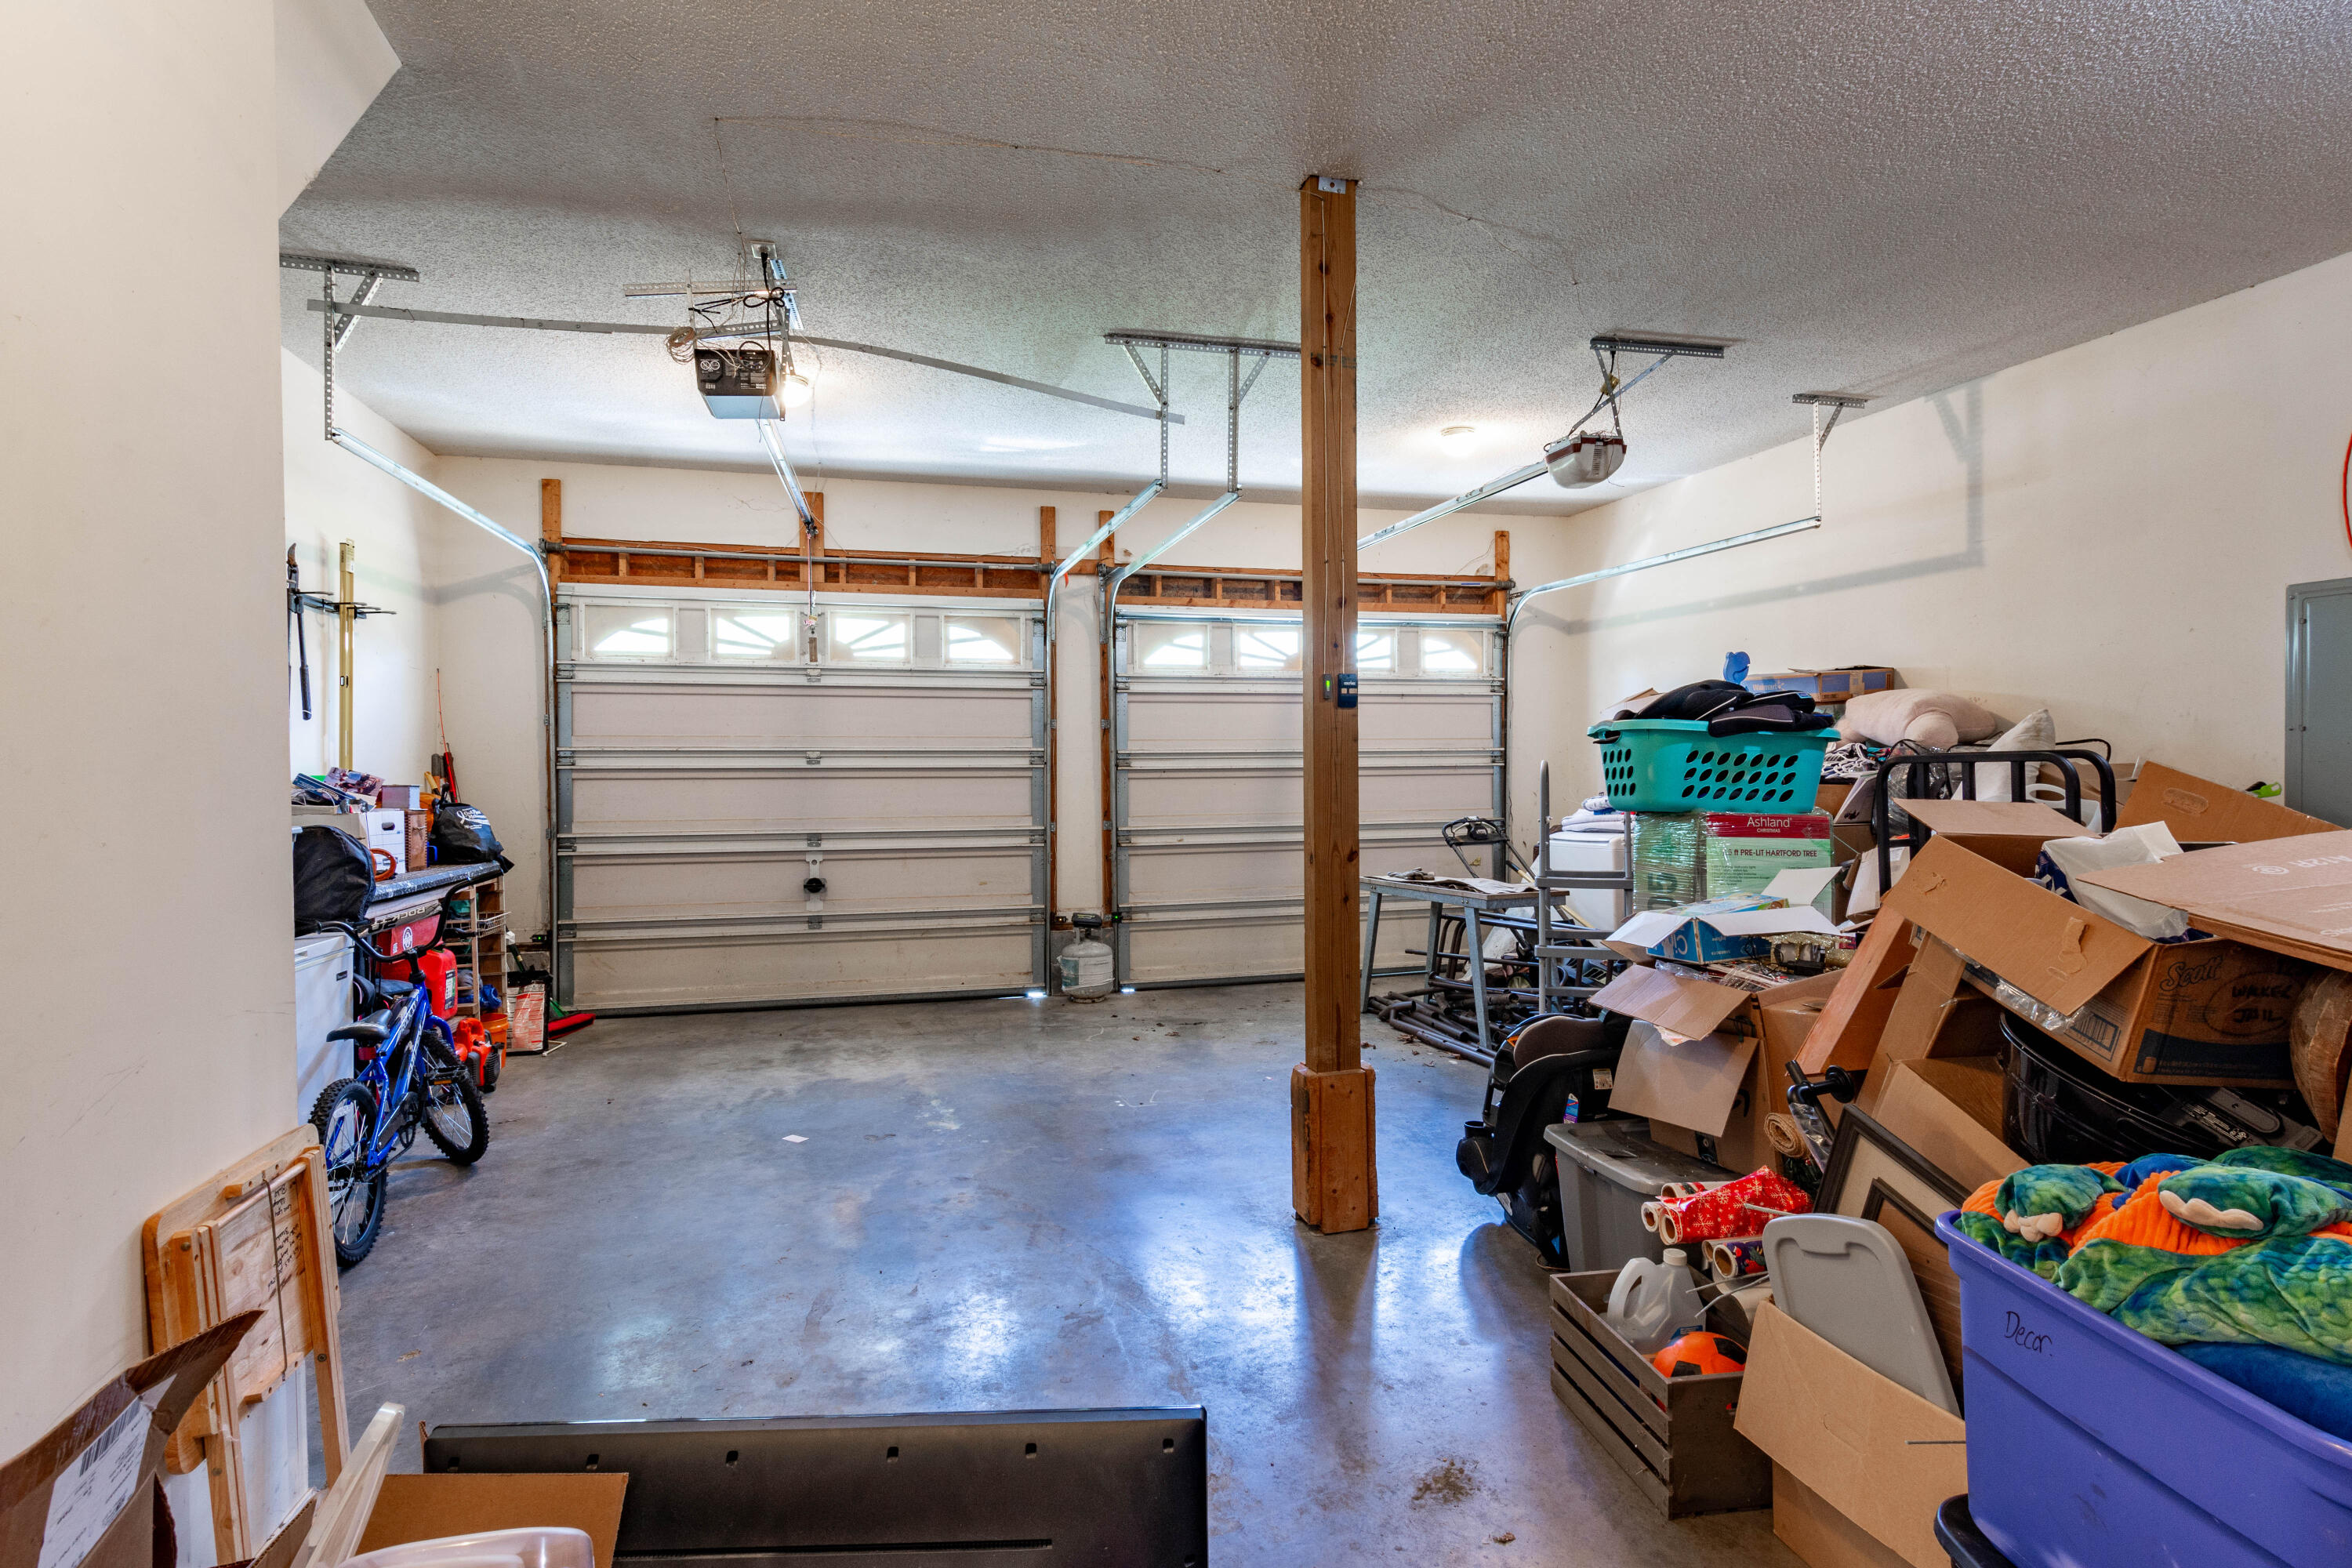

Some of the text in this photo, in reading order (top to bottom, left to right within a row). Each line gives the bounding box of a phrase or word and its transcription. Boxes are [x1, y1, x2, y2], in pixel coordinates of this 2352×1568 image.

[1746, 816, 1791, 828] Ashland
[2159, 955, 2223, 992] Scott
[2004, 1310, 2053, 1354] Decor
